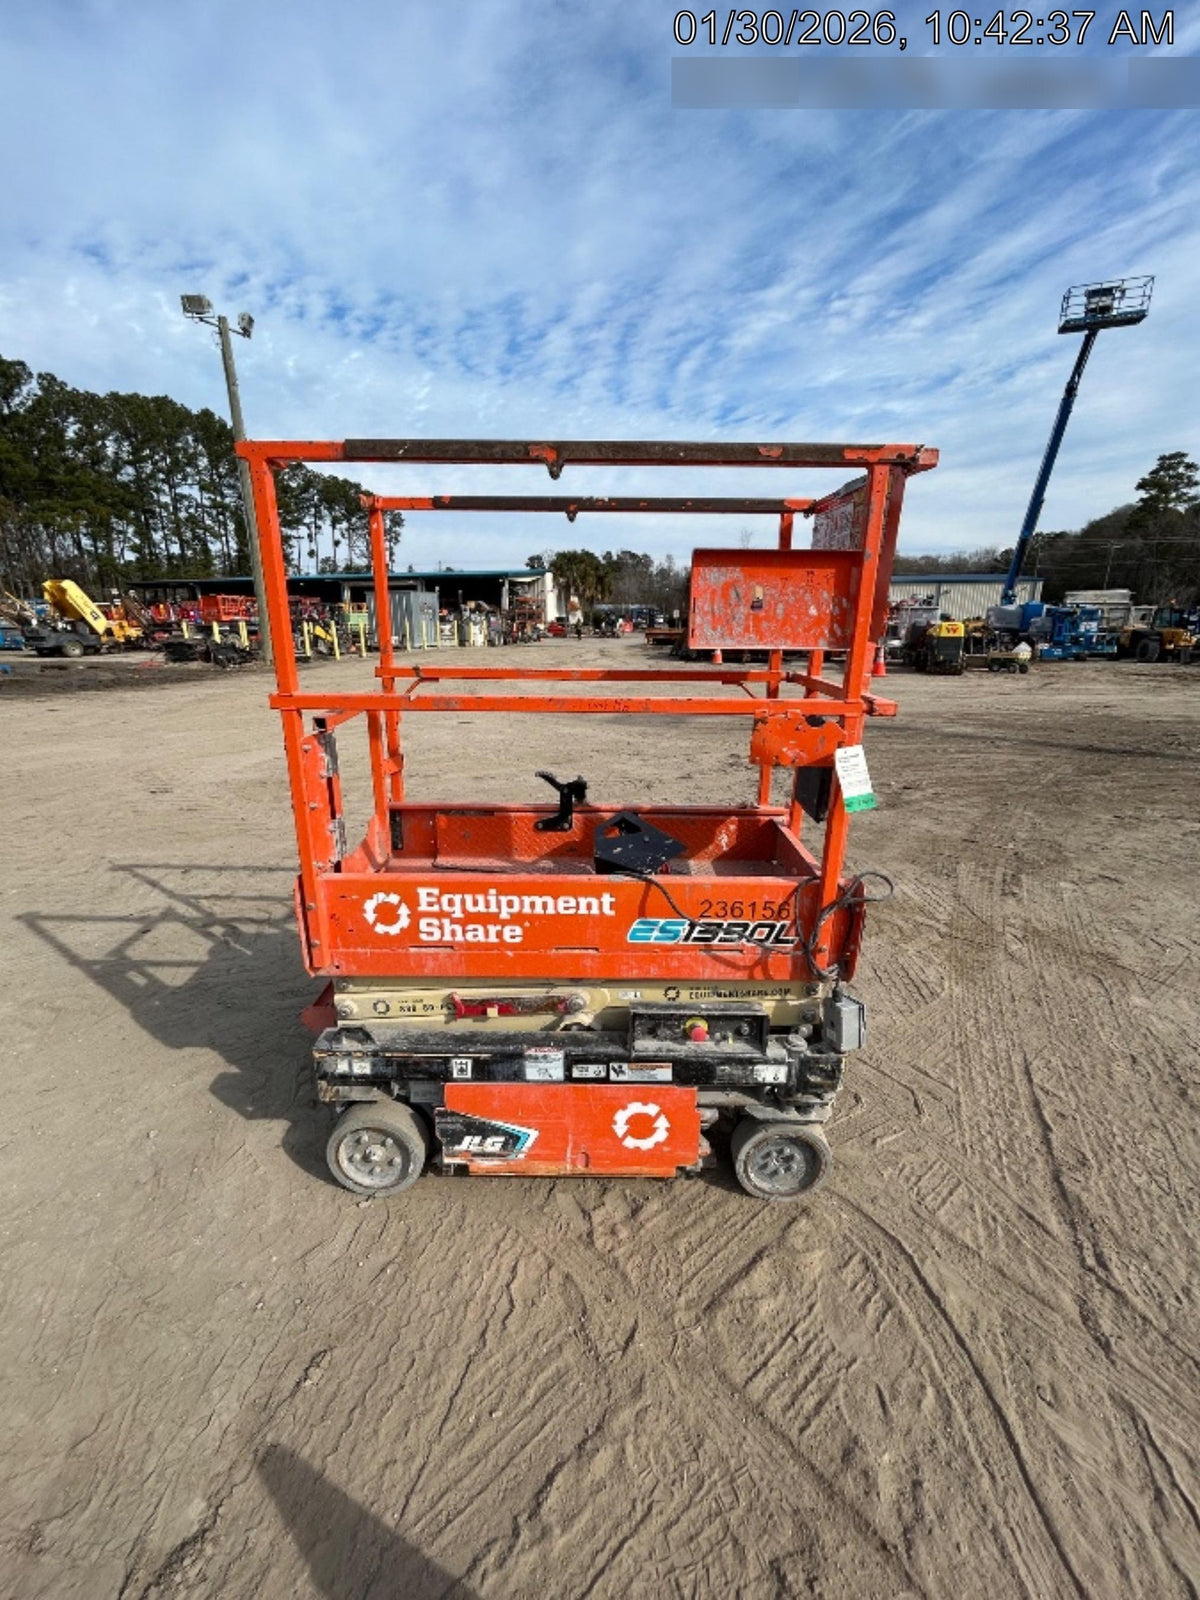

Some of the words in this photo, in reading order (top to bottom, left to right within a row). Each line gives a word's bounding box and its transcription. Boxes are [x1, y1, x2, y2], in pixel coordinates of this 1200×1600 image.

[416, 886, 616, 919] Equipment
[699, 899, 791, 920] 236156
[418, 917, 524, 944] Share
[627, 918, 800, 946] ES1330L
[453, 1135, 506, 1151] JLG
